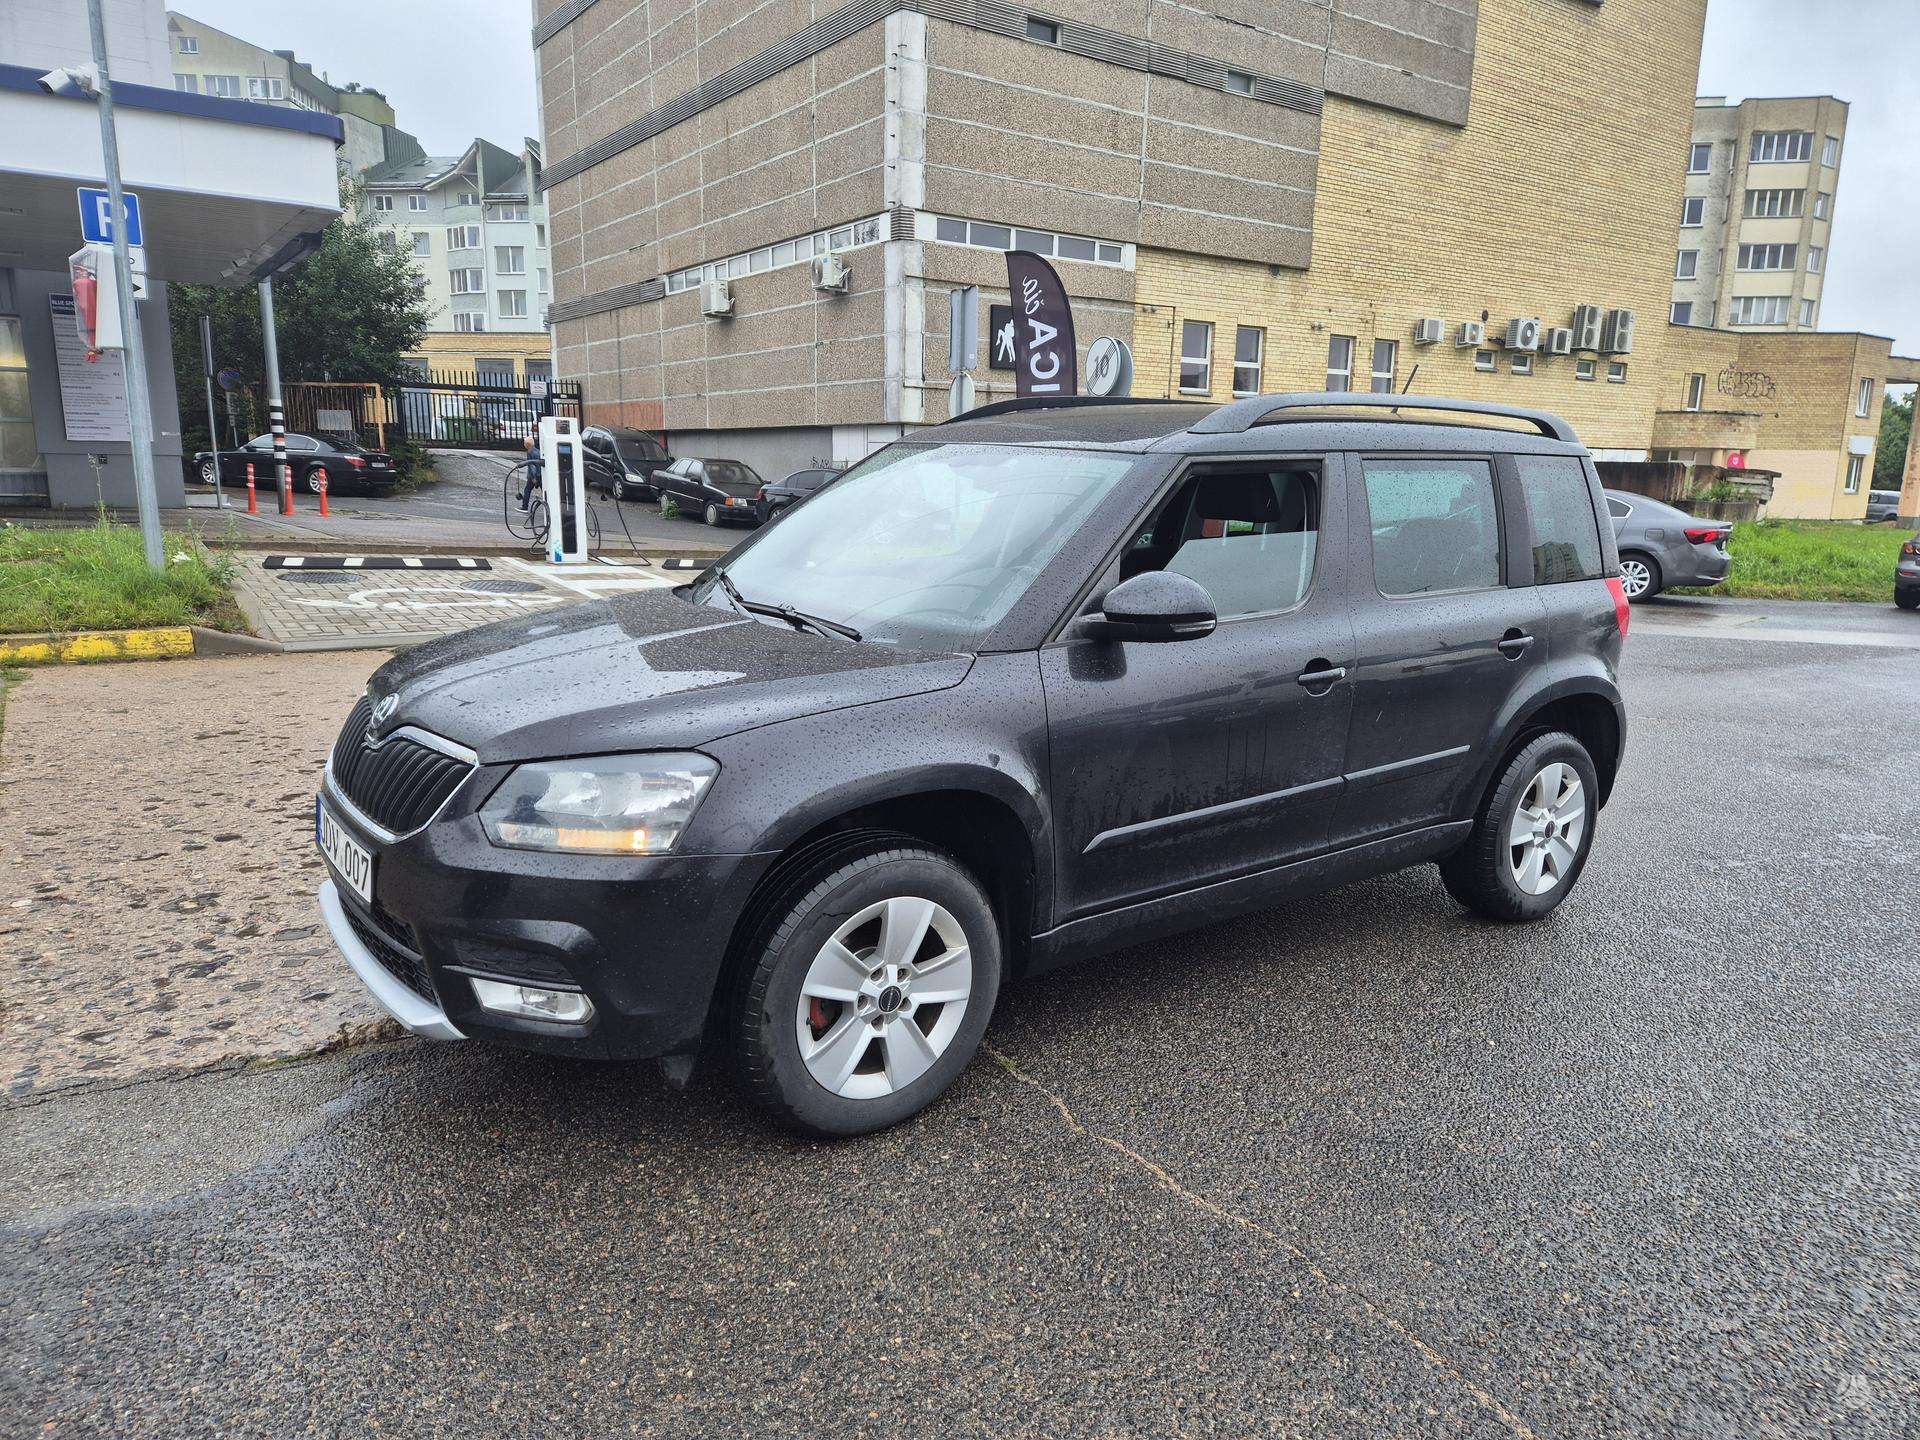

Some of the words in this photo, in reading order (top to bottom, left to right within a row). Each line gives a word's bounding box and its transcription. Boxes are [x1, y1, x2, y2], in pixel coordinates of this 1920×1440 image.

[96, 195, 128, 237] P
[1094, 354, 1110, 378] 10
[344, 840, 369, 892] 007
